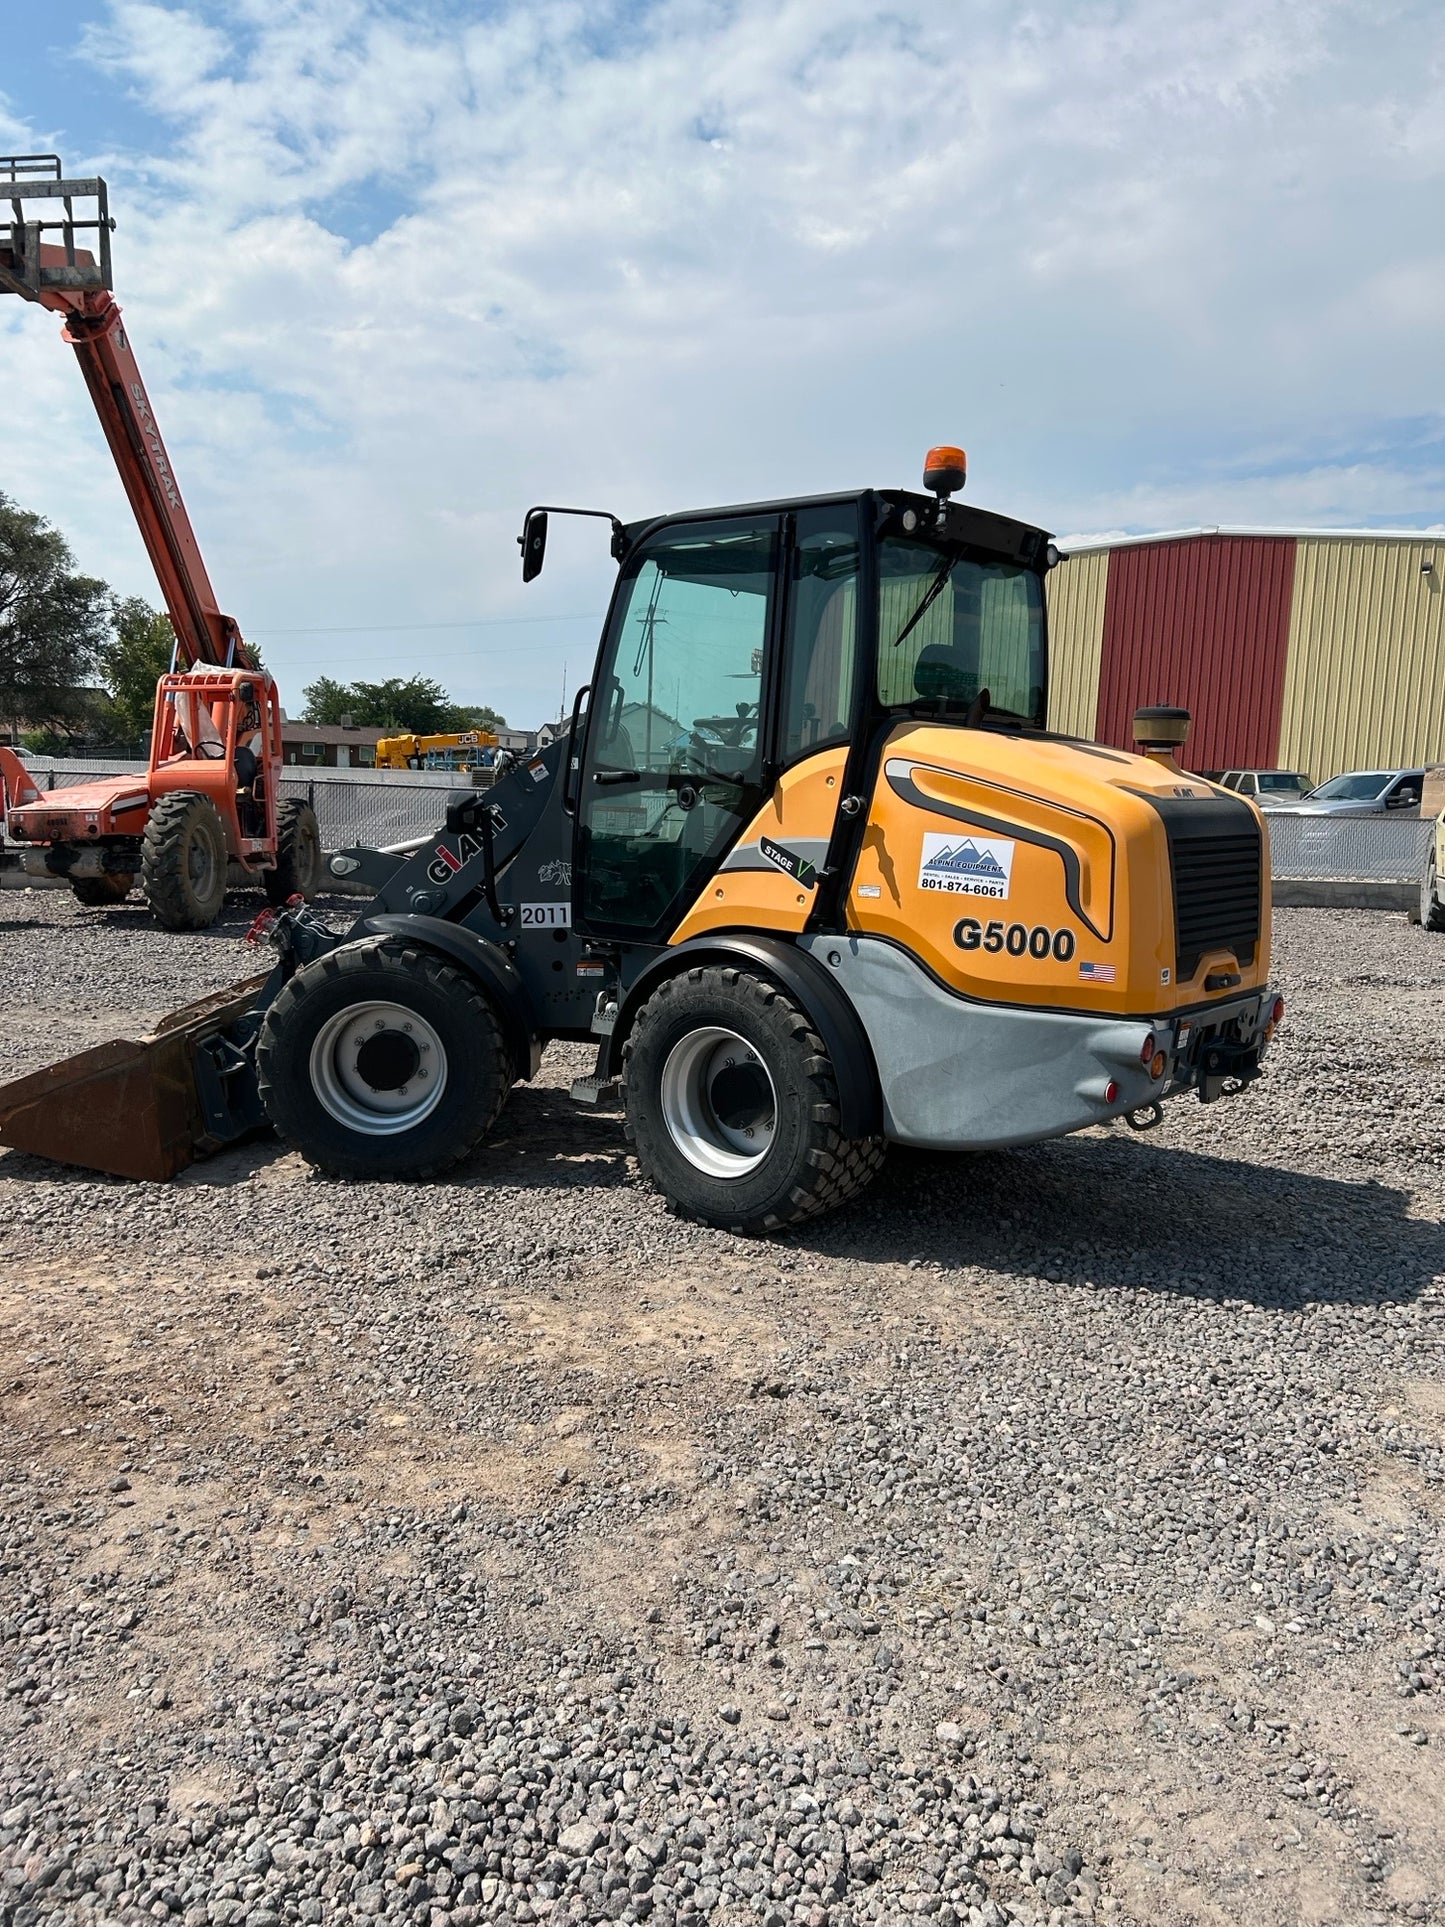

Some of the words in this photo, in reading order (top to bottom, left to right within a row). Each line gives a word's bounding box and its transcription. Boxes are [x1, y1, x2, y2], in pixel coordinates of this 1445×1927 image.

[130, 383, 181, 509] SKYTRAK
[458, 734, 478, 744] JCB
[427, 803, 508, 885] GIAT
[764, 845, 794, 871] STAGE
[928, 858, 955, 868] ALPINE
[957, 860, 1003, 873] EQUIPMENT
[921, 878, 1005, 898] 801-874-6061
[522, 907, 567, 924] 2011
[953, 917, 1077, 963] G5000
